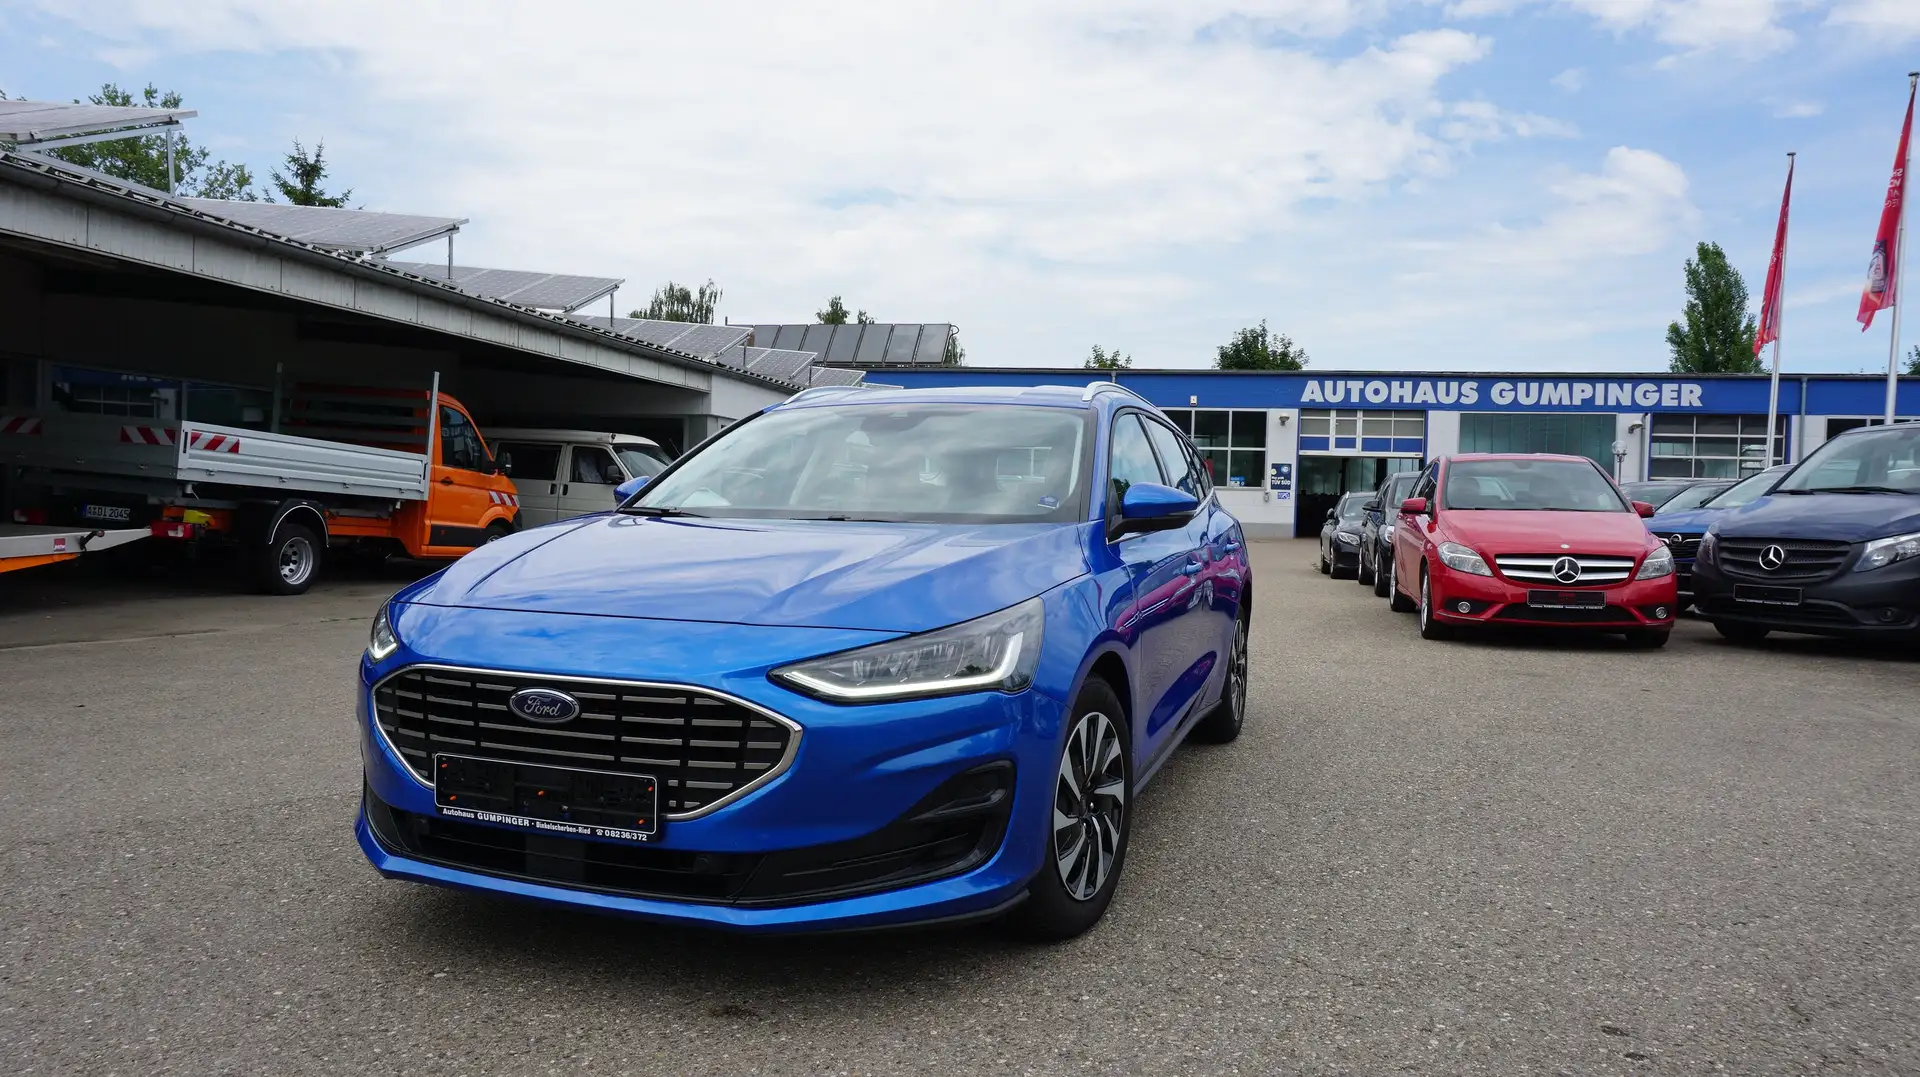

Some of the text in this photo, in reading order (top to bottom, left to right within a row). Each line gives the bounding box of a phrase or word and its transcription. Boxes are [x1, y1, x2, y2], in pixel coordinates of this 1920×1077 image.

[1301, 380, 1703, 407] AUTOHAUS GUMPINGER
[524, 695, 560, 716] Ford
[443, 807, 475, 820] Autohaus
[478, 812, 530, 827] GUMPINGER
[604, 829, 648, 842] 08236/372
